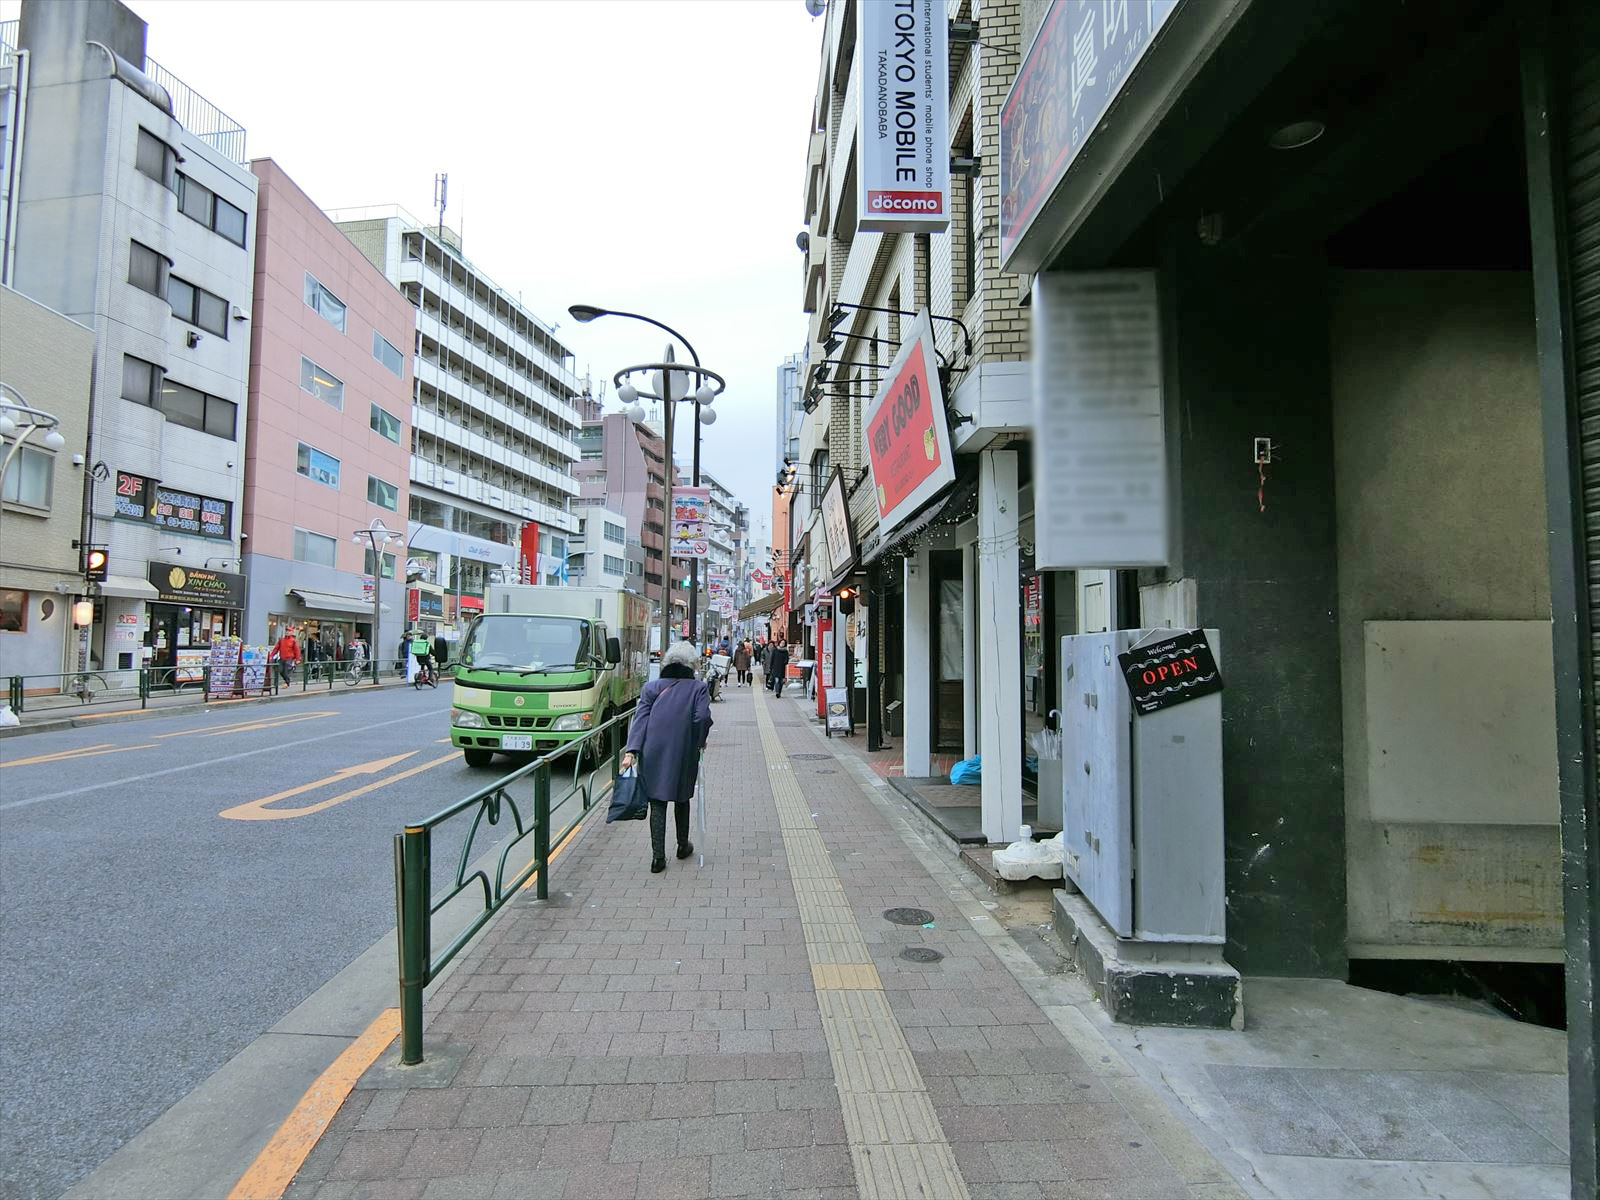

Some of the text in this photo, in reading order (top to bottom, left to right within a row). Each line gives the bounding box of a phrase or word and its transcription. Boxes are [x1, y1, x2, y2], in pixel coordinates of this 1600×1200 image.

[878, 49, 888, 140] TAKADANOBABA
[895, 1, 916, 183] TOKYO MOBILE
[924, 0, 934, 189] international students' mobile phone shop
[871, 194, 938, 210] docomo
[872, 412, 891, 459] VERY
[891, 374, 921, 438] GOOD
[118, 474, 143, 497] 2F
[188, 578, 203, 587] XIN
[1147, 641, 1177, 655] Welcome!
[1142, 656, 1198, 685] OPEN
